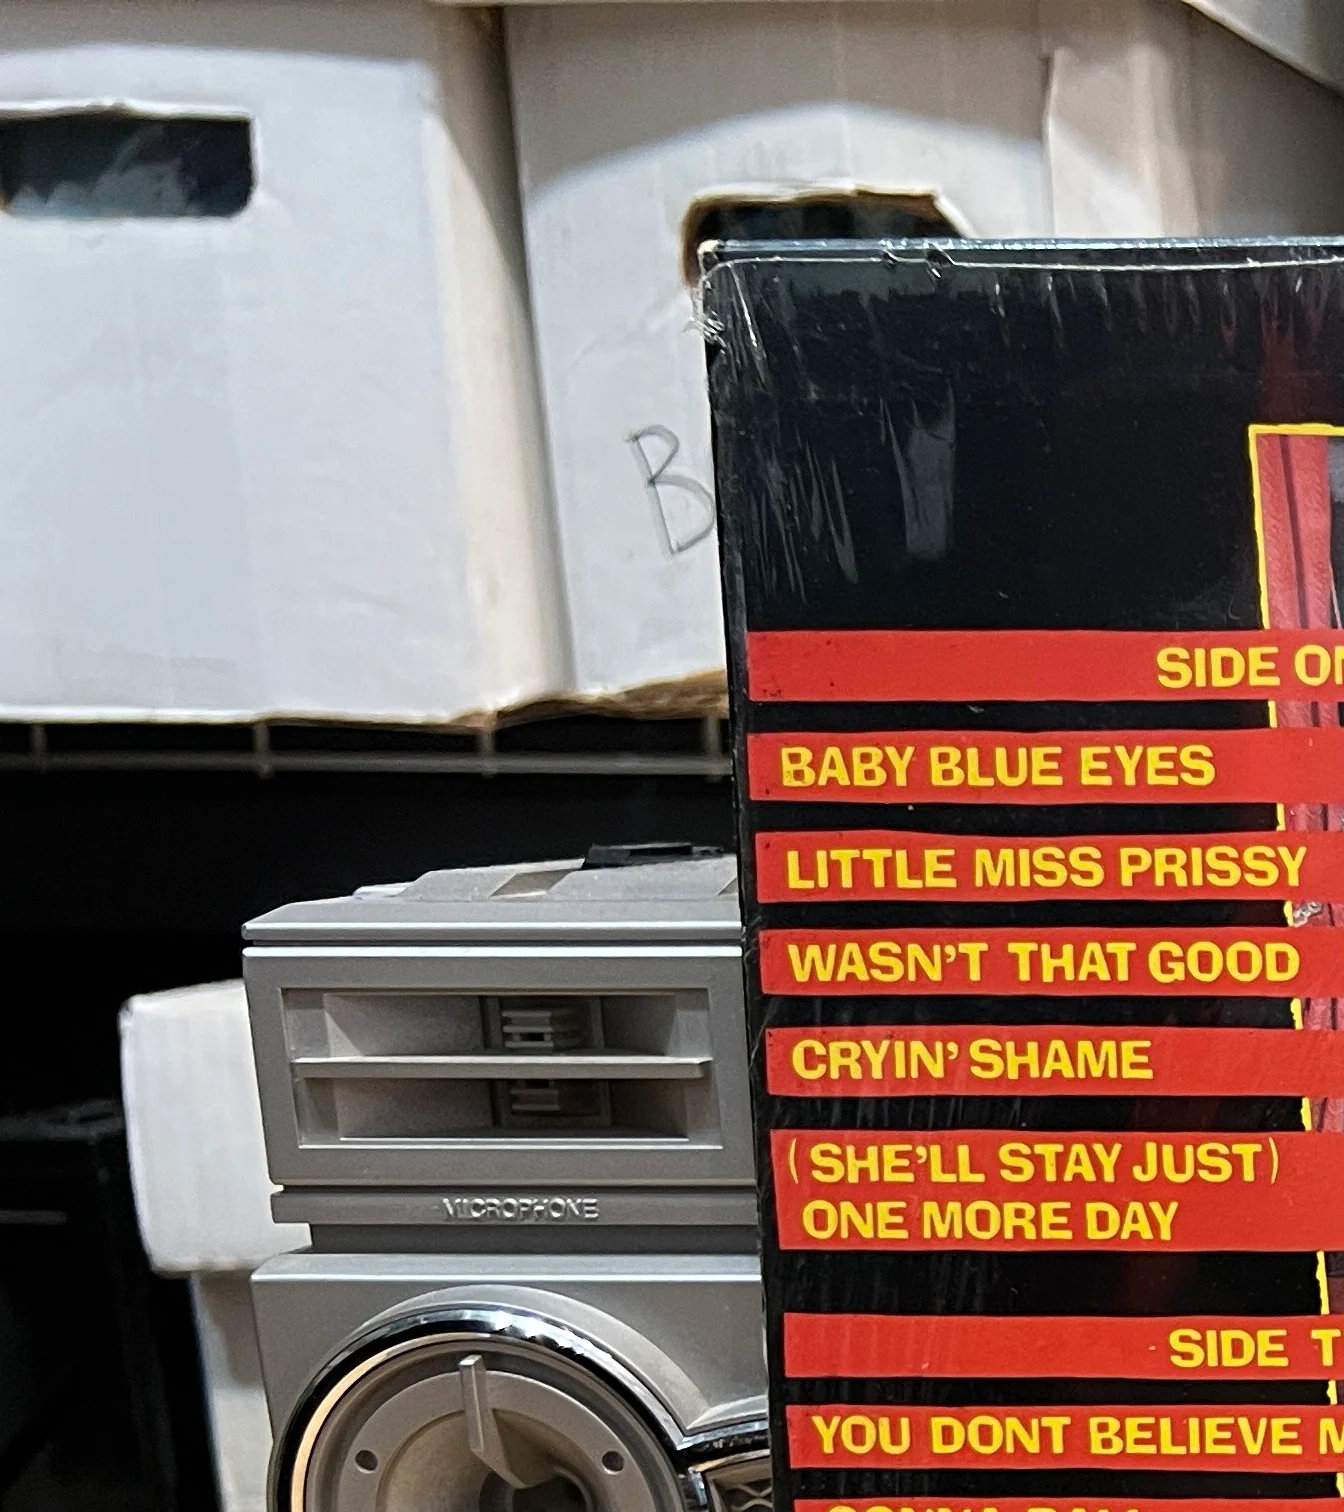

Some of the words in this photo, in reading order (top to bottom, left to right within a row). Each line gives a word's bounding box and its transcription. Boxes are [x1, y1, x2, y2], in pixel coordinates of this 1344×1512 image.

[1156, 646, 1280, 689] SIDE
[781, 746, 914, 787] BABY
[929, 746, 1063, 787] BLUE
[1080, 744, 1215, 786] EYES
[787, 848, 957, 889] LITTLE
[975, 846, 1104, 887] MISS
[1119, 845, 1307, 887] PRISSY
[788, 941, 988, 982] WASN'T
[1007, 942, 1136, 983] THAT
[1148, 941, 1300, 983] GOOD
[791, 1039, 959, 1080] CRYIN'
[969, 1038, 1153, 1080] SHAME
[998, 1142, 1121, 1183] STAY
[442, 1197, 600, 1221] MICROPHONE
[802, 1199, 909, 1239] ONE
[923, 1200, 1073, 1240] MORE
[1085, 1201, 1178, 1241] DAY
[1169, 1328, 1289, 1368] SIDE
[812, 1415, 910, 1455] YOU
[930, 1415, 1071, 1454] DONT
[1089, 1416, 1302, 1455] BELIEVE
